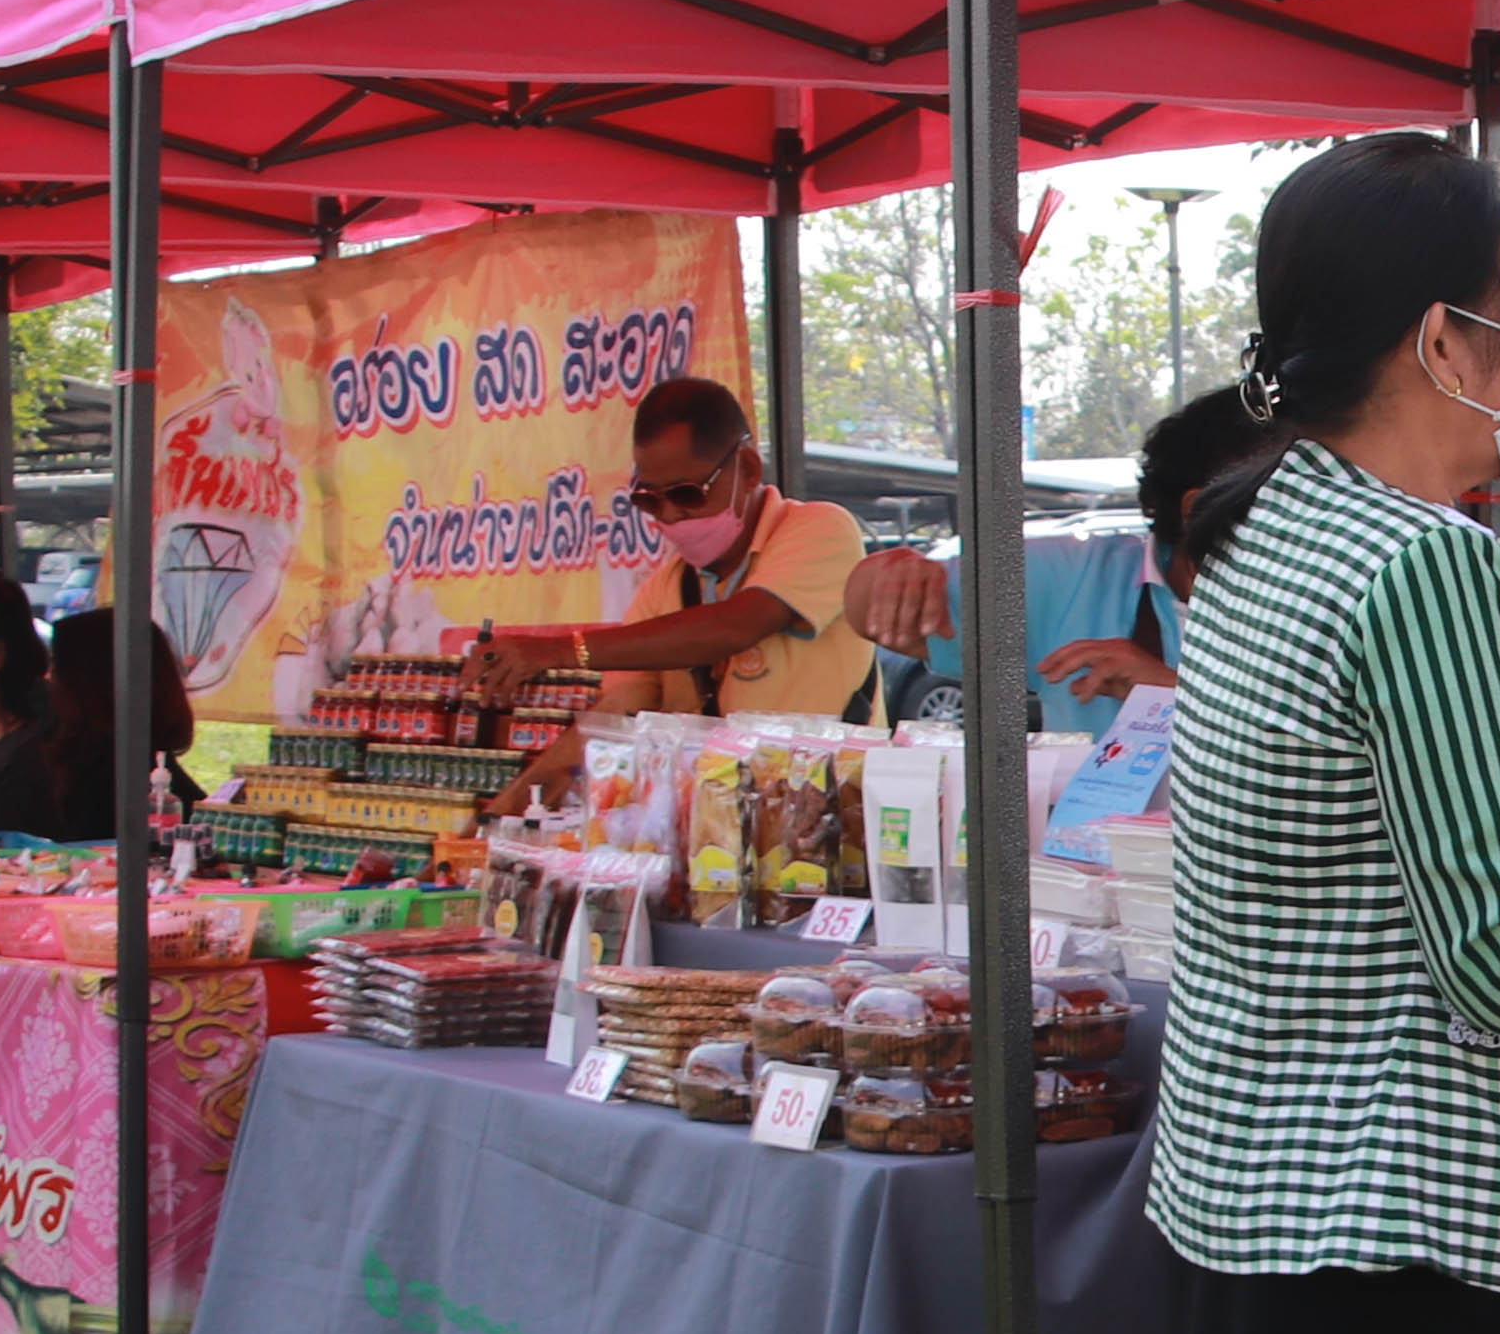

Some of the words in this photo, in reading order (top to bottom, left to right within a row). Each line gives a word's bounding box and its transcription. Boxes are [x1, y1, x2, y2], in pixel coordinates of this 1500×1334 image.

[329, 315, 454, 427] อร่อย
[473, 324, 541, 409] สด
[562, 305, 695, 401] สะอาด
[771, 1089, 814, 1127] 50.-
